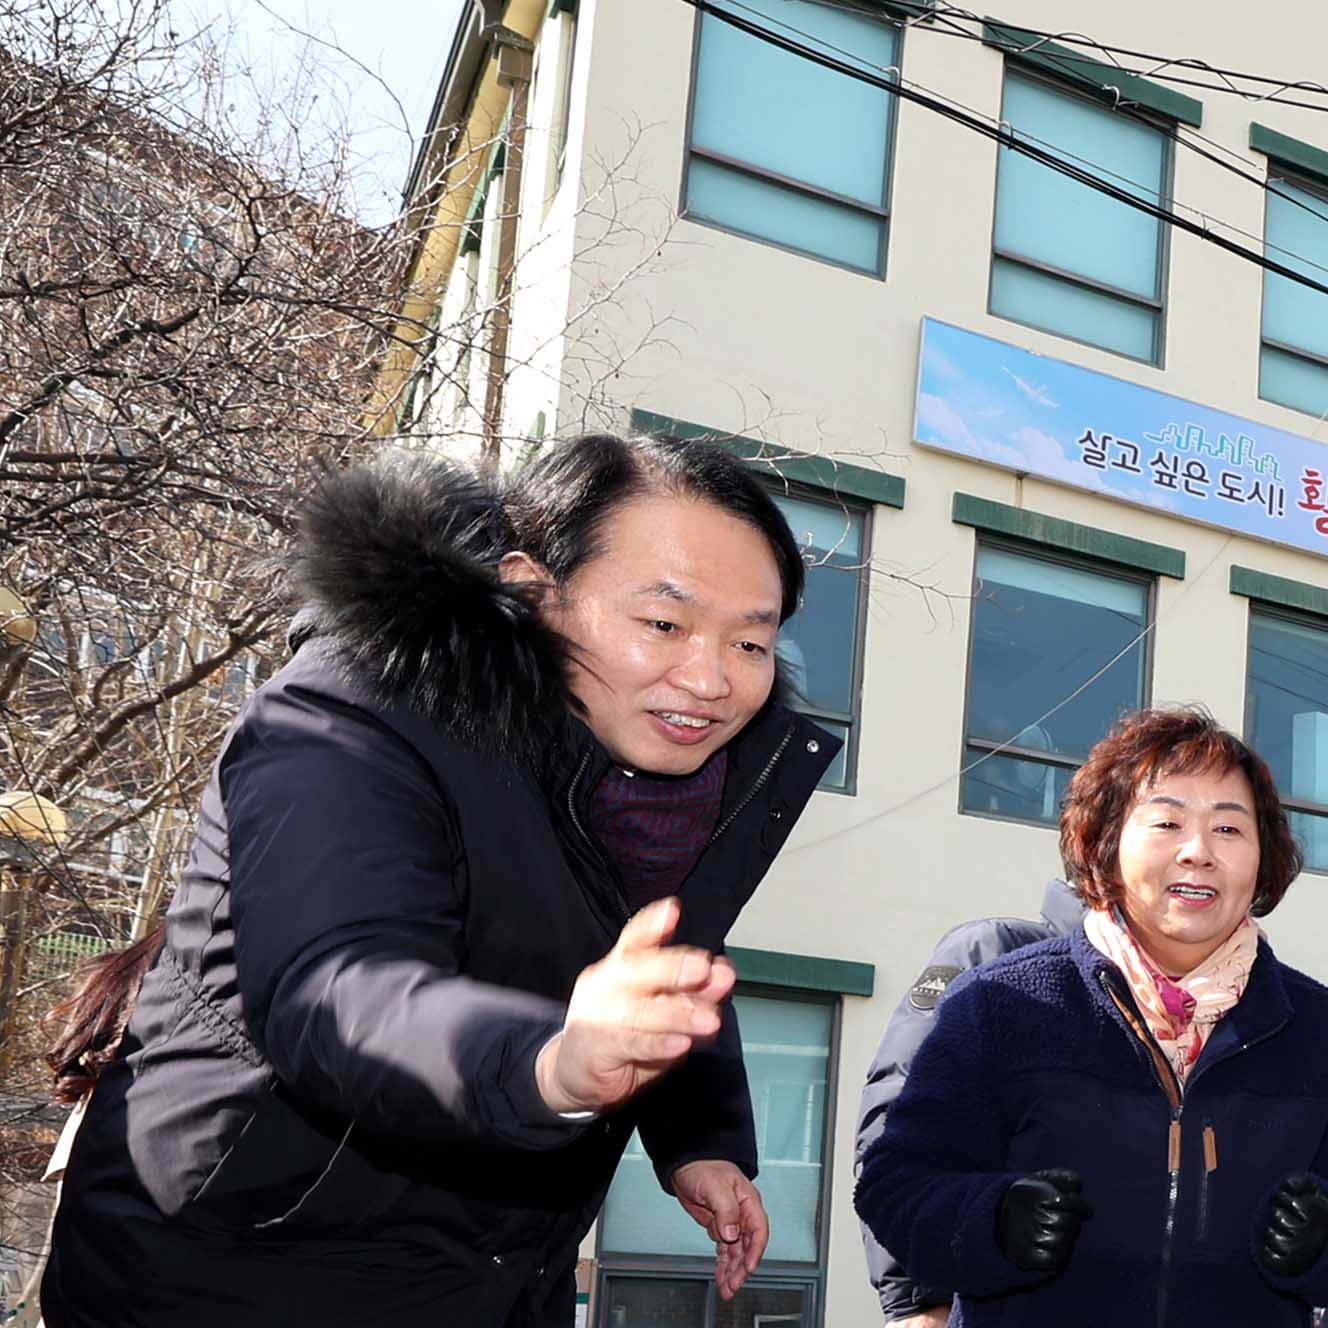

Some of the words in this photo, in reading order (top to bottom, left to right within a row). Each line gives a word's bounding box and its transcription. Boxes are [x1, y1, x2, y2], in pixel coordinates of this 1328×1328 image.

[1078, 429, 1142, 473] 살고
[1149, 450, 1211, 498] 싶은
[1216, 471, 1285, 517] 도시!
